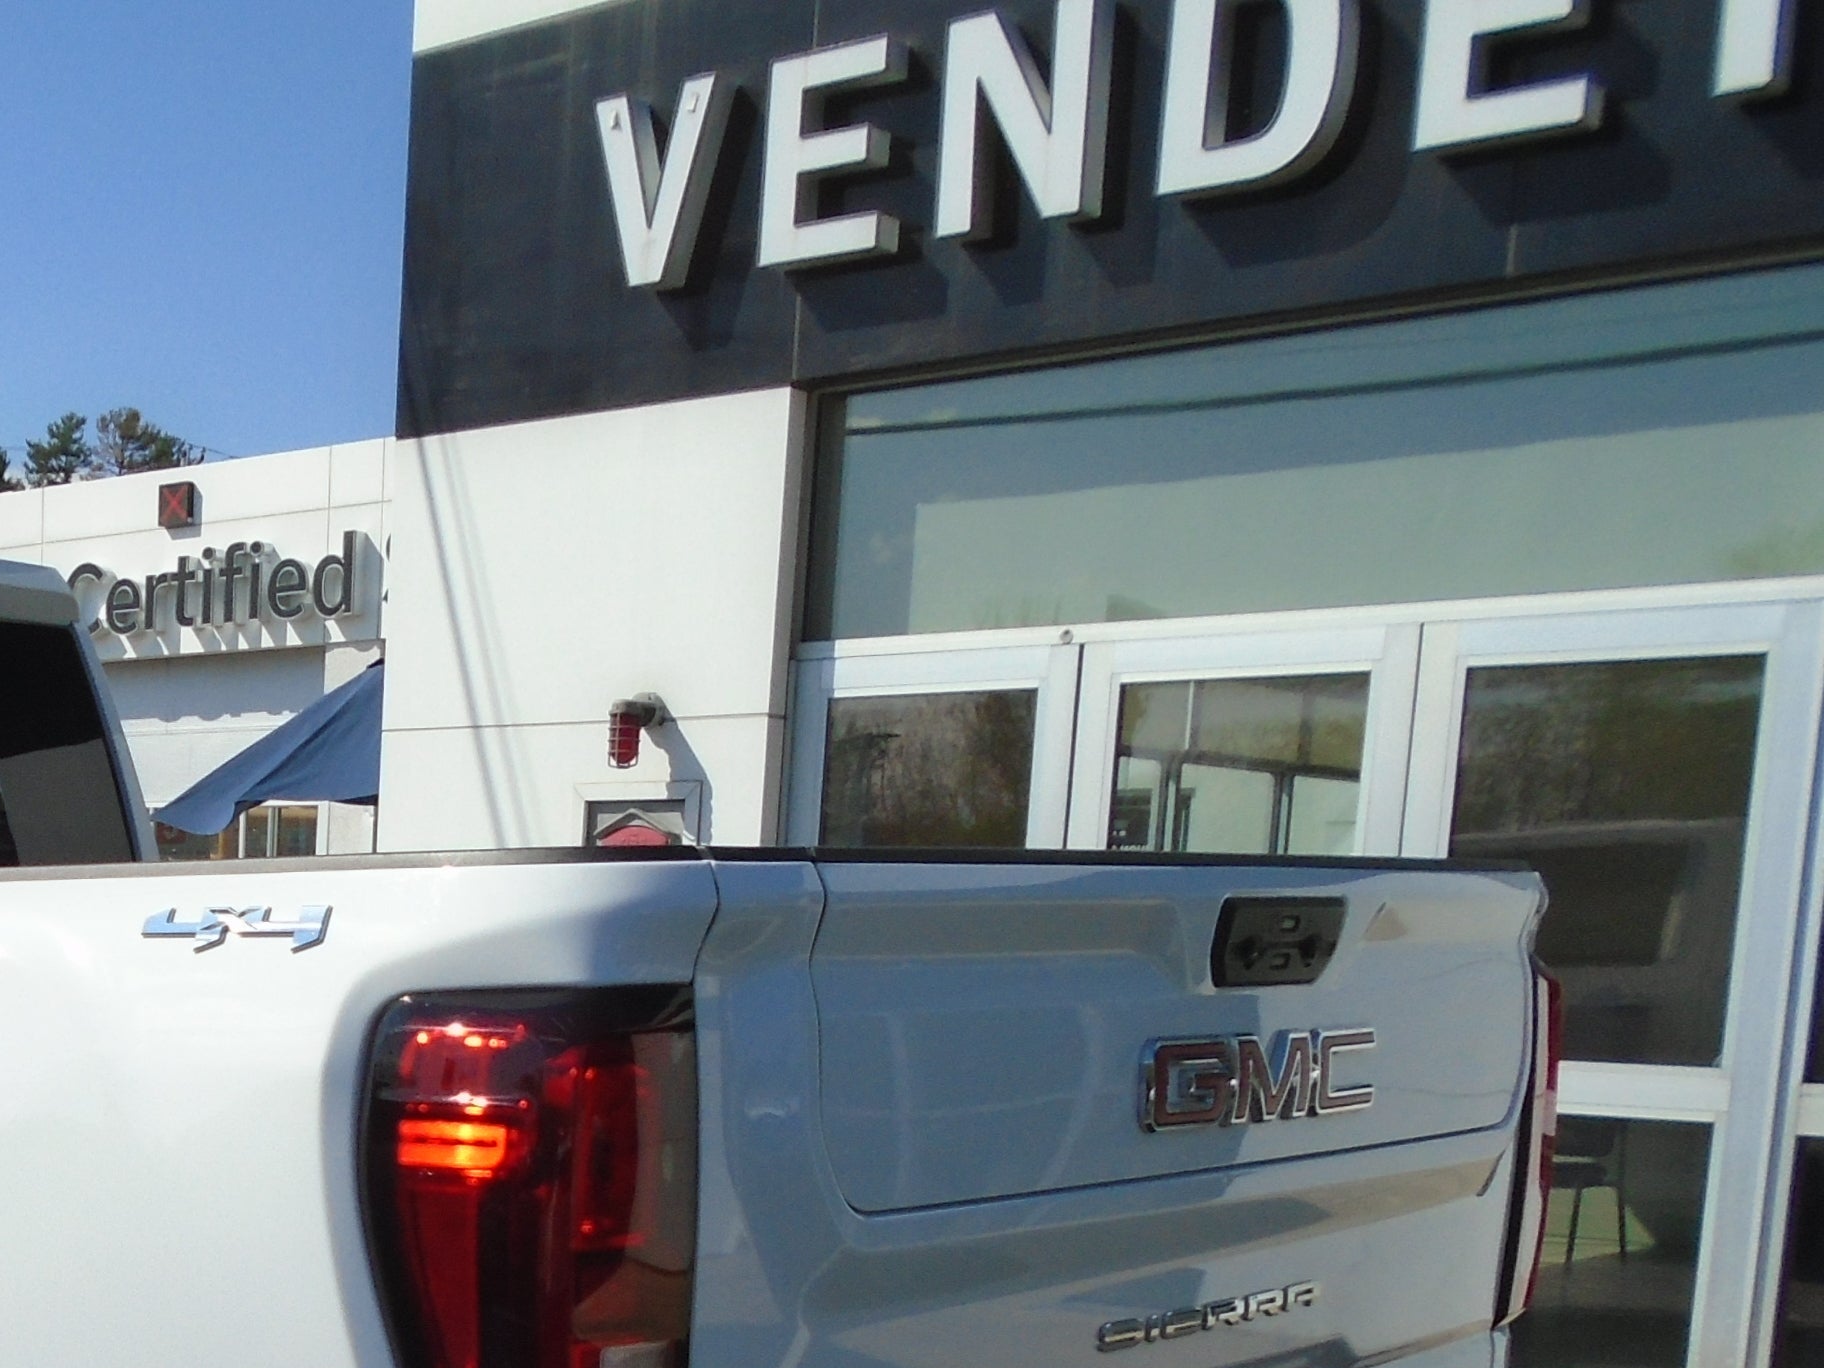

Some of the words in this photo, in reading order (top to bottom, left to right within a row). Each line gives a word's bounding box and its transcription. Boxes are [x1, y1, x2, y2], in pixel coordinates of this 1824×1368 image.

[67, 530, 362, 635] Certified
[1138, 1028, 1376, 1133] GMC
[1097, 1279, 1322, 1353] SIERRA
